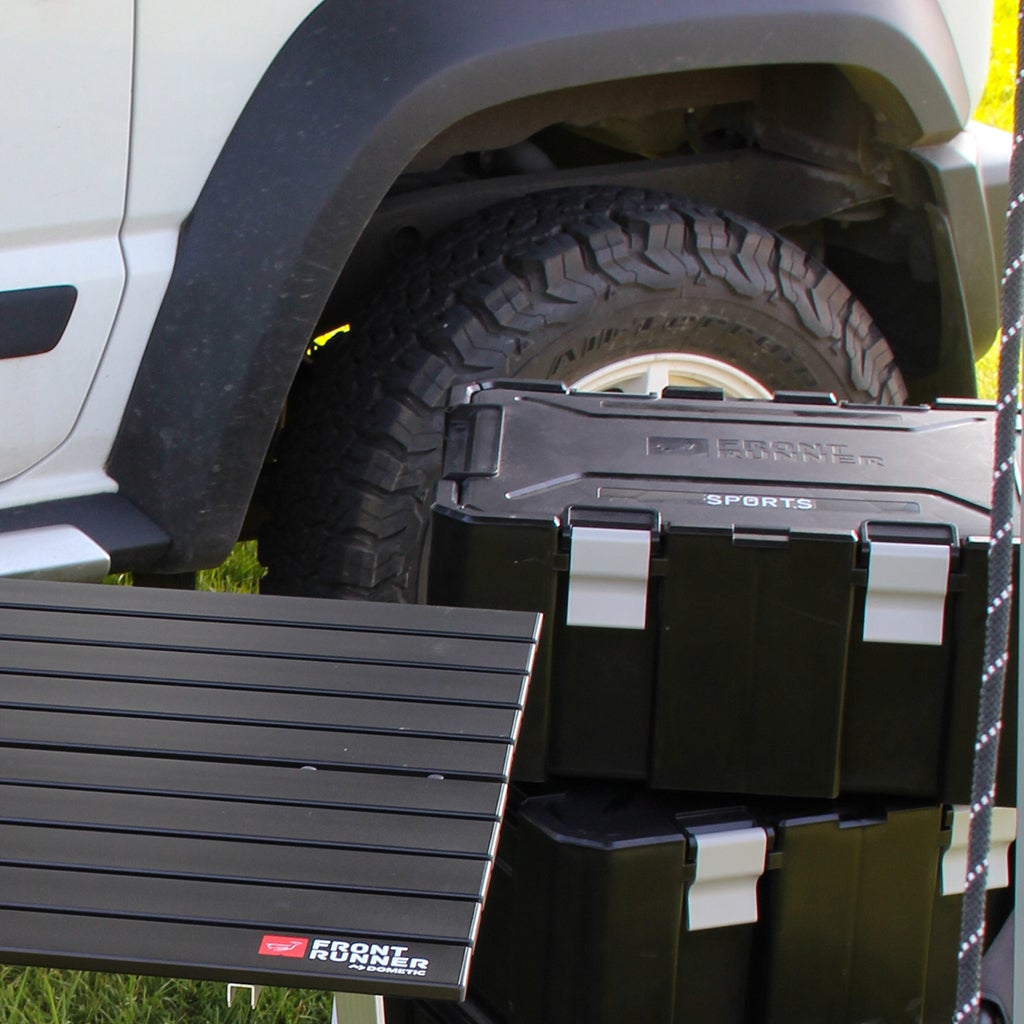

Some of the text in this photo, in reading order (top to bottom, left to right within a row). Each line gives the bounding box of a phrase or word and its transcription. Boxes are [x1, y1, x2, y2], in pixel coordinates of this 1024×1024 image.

[716, 438, 849, 456] FRONT
[715, 449, 884, 467] RUNNER
[706, 494, 814, 510] SPORTS
[312, 939, 409, 957] FRONT
[309, 949, 429, 970] RUNNER
[366, 965, 427, 976] DOMETIC
